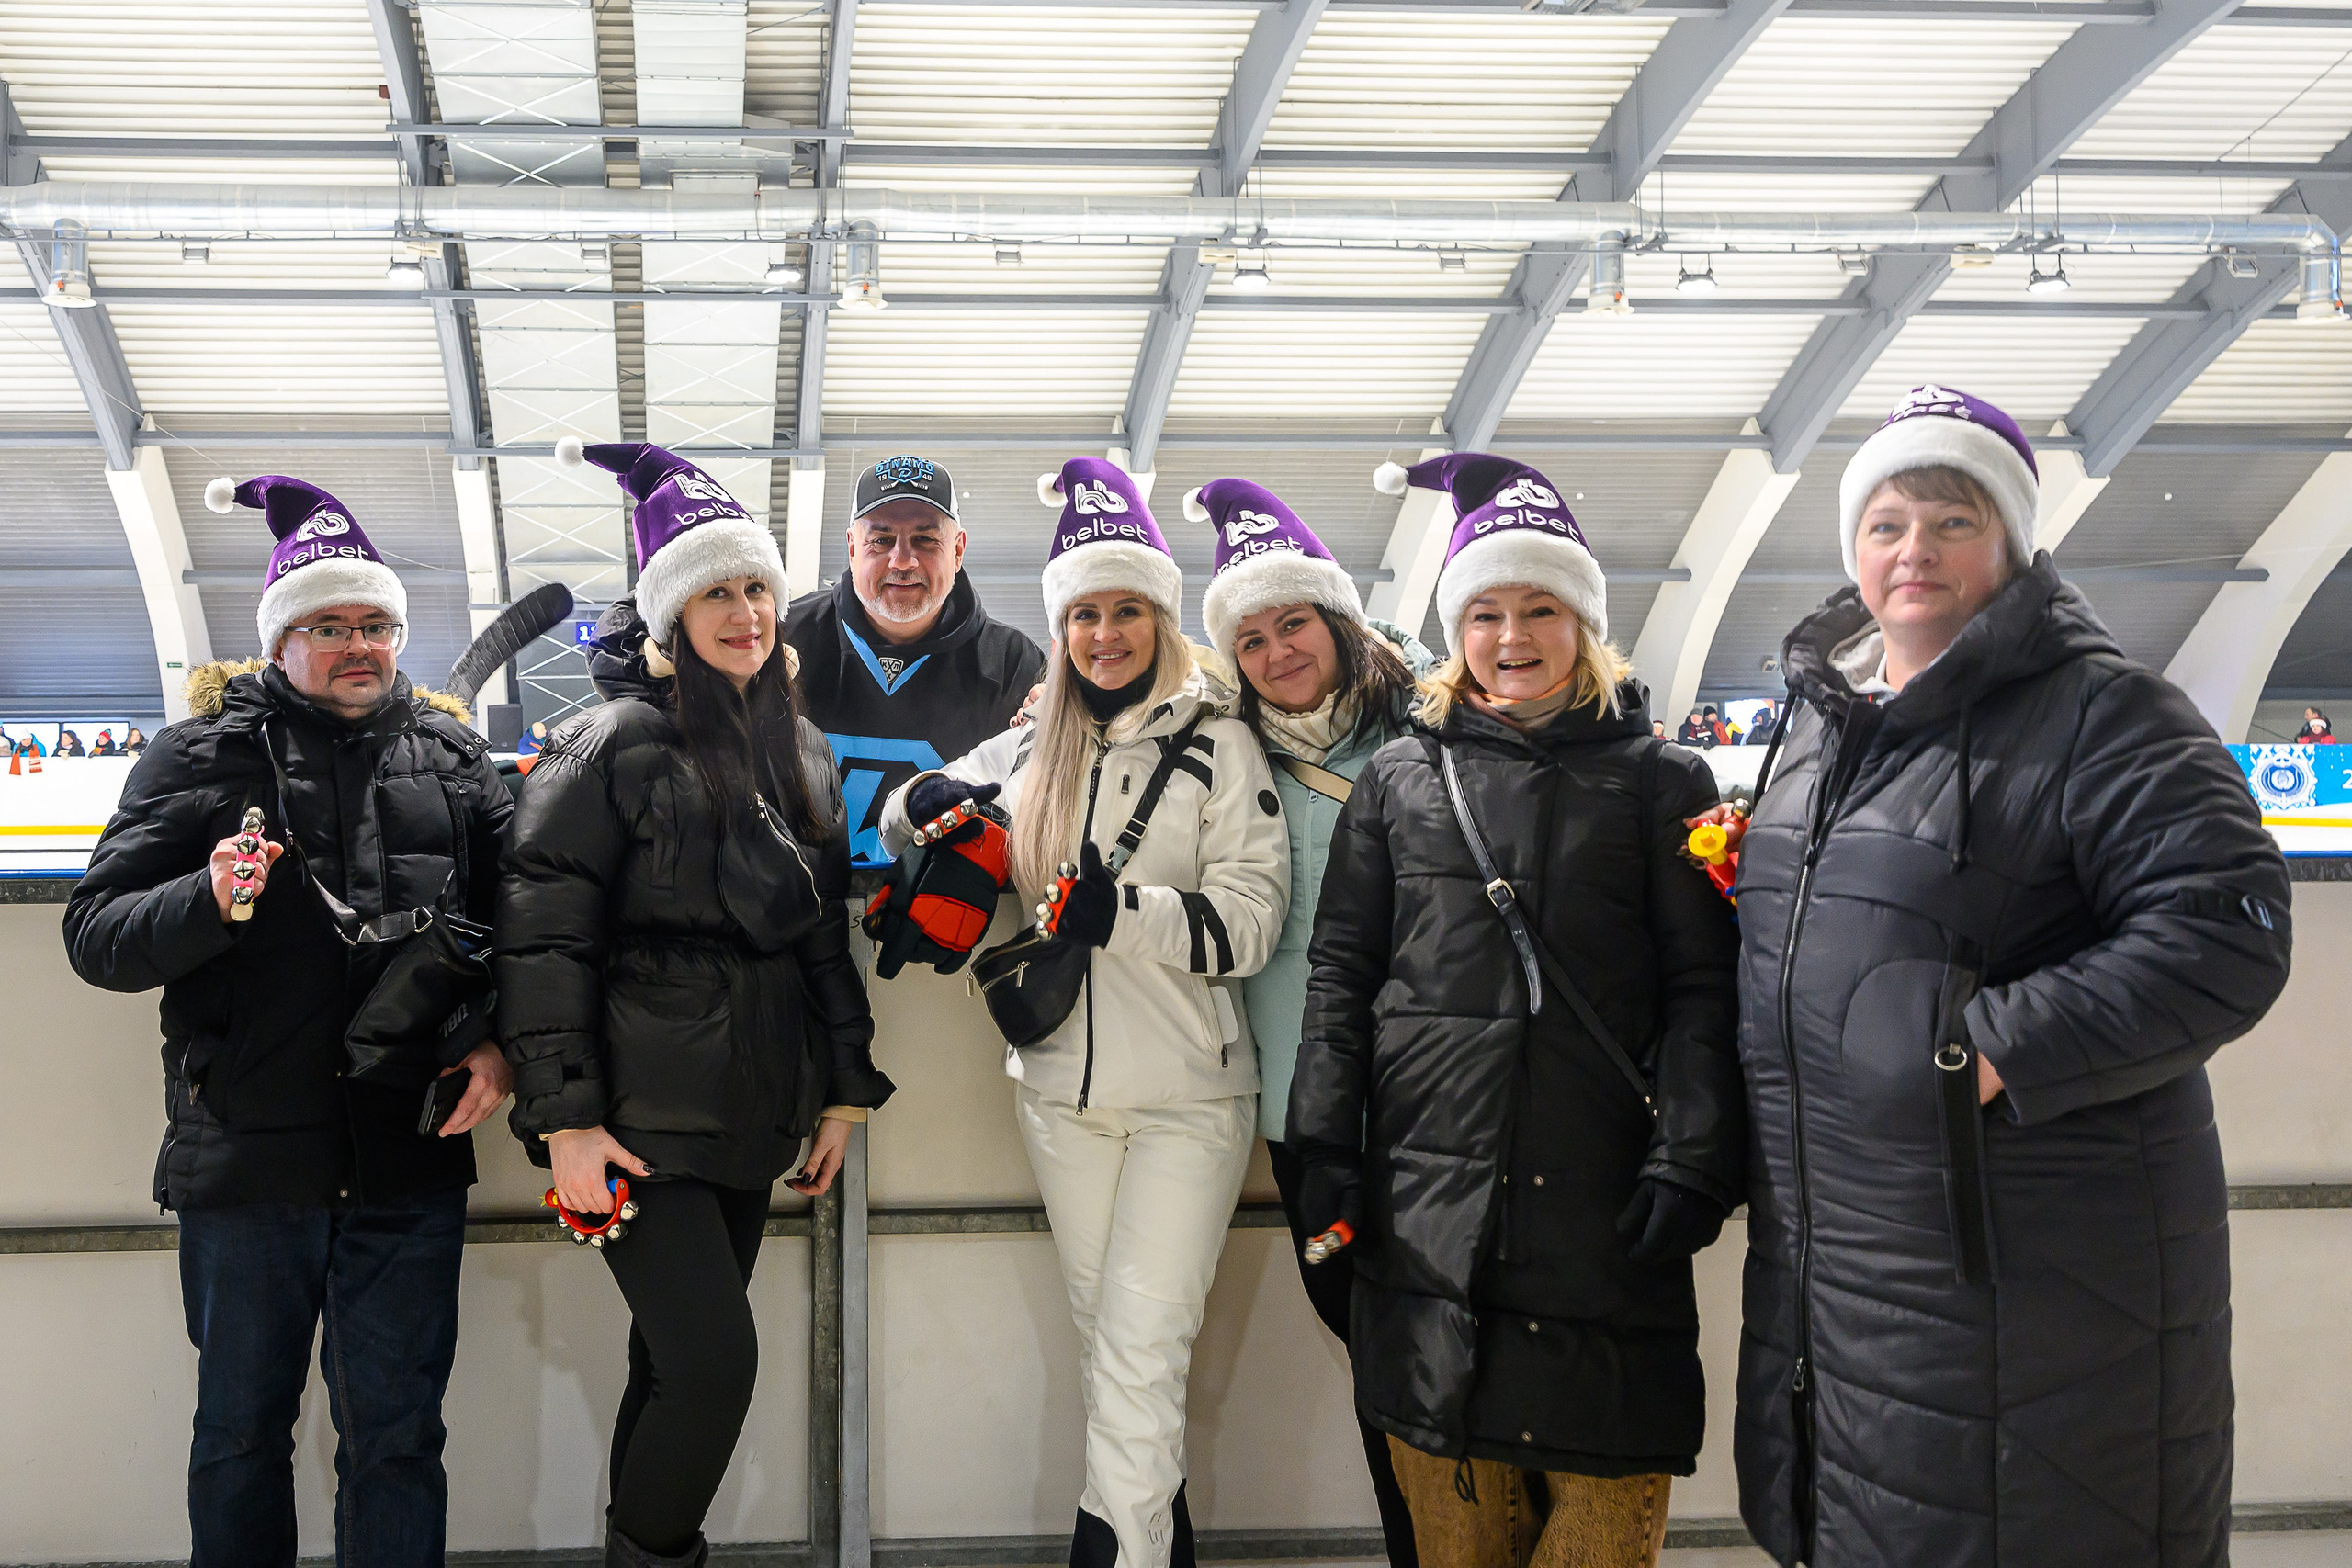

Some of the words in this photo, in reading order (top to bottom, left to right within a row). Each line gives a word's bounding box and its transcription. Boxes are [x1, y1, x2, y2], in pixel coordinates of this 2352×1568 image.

[876, 458, 934, 474] DINAMO
[922, 473, 933, 481] 48
[1061, 517, 1150, 551] belbet
[1474, 508, 1579, 544] belbet
[277, 541, 369, 575] belbet
